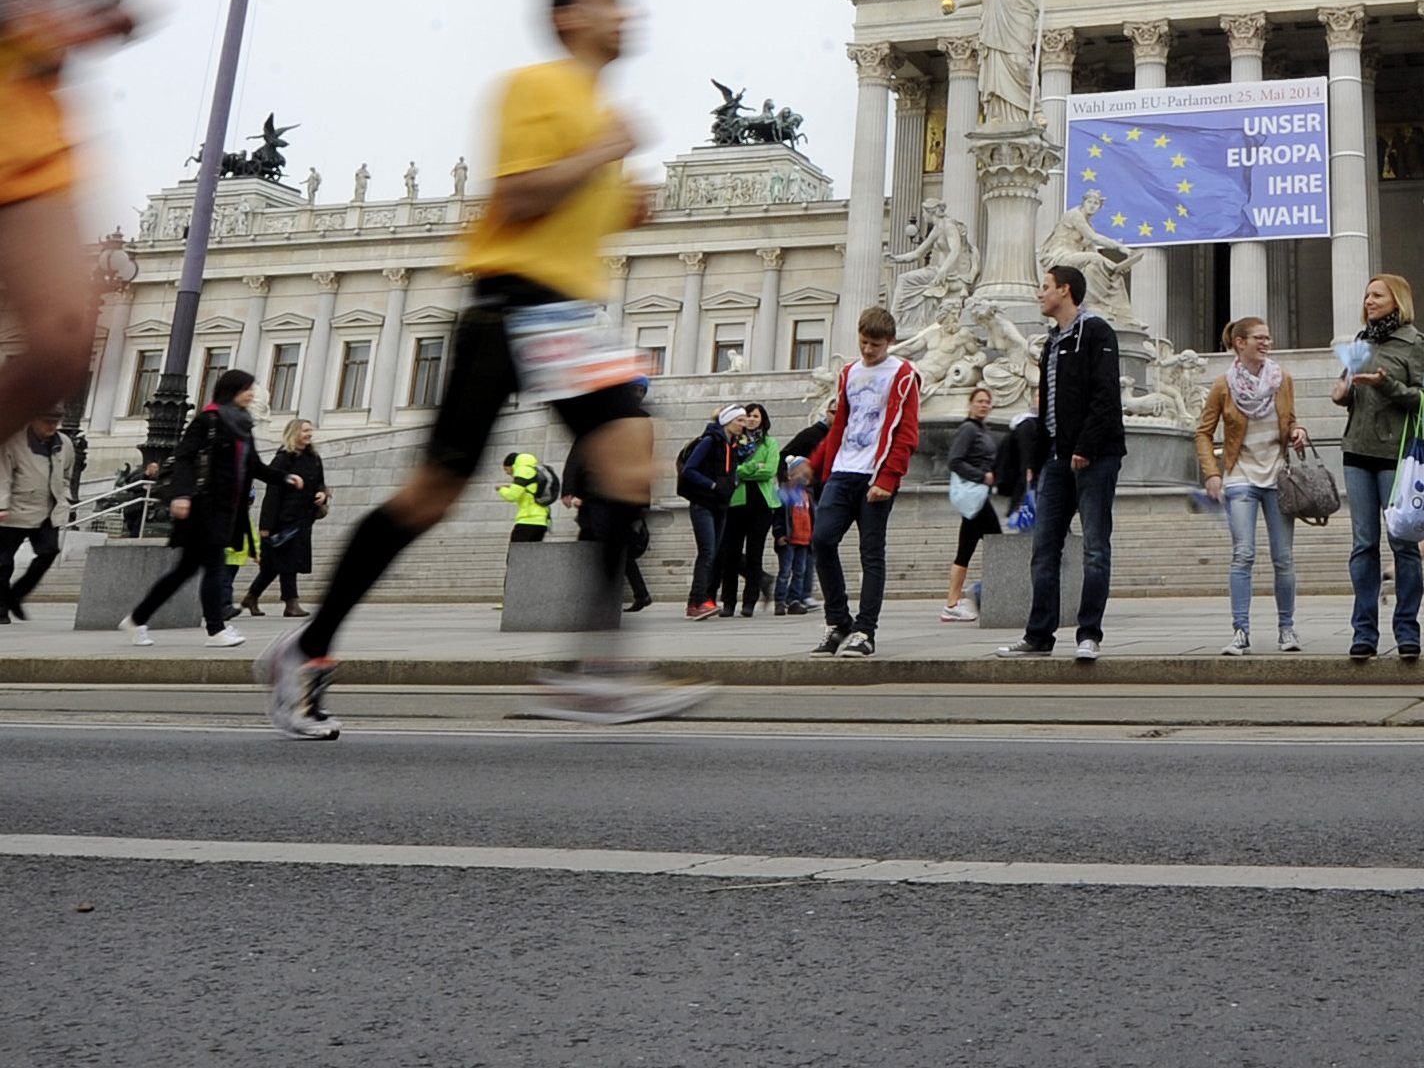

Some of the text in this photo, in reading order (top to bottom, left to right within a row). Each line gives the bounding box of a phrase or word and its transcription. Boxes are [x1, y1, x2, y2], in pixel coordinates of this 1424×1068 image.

[1073, 86, 1320, 114] Wahl zum EU-Parlament 25. Mai 2014
[1243, 113, 1322, 136] UNSER
[1226, 143, 1322, 168] EUROPA
[1268, 173, 1323, 196] IHRE
[1252, 204, 1324, 227] WAHL
